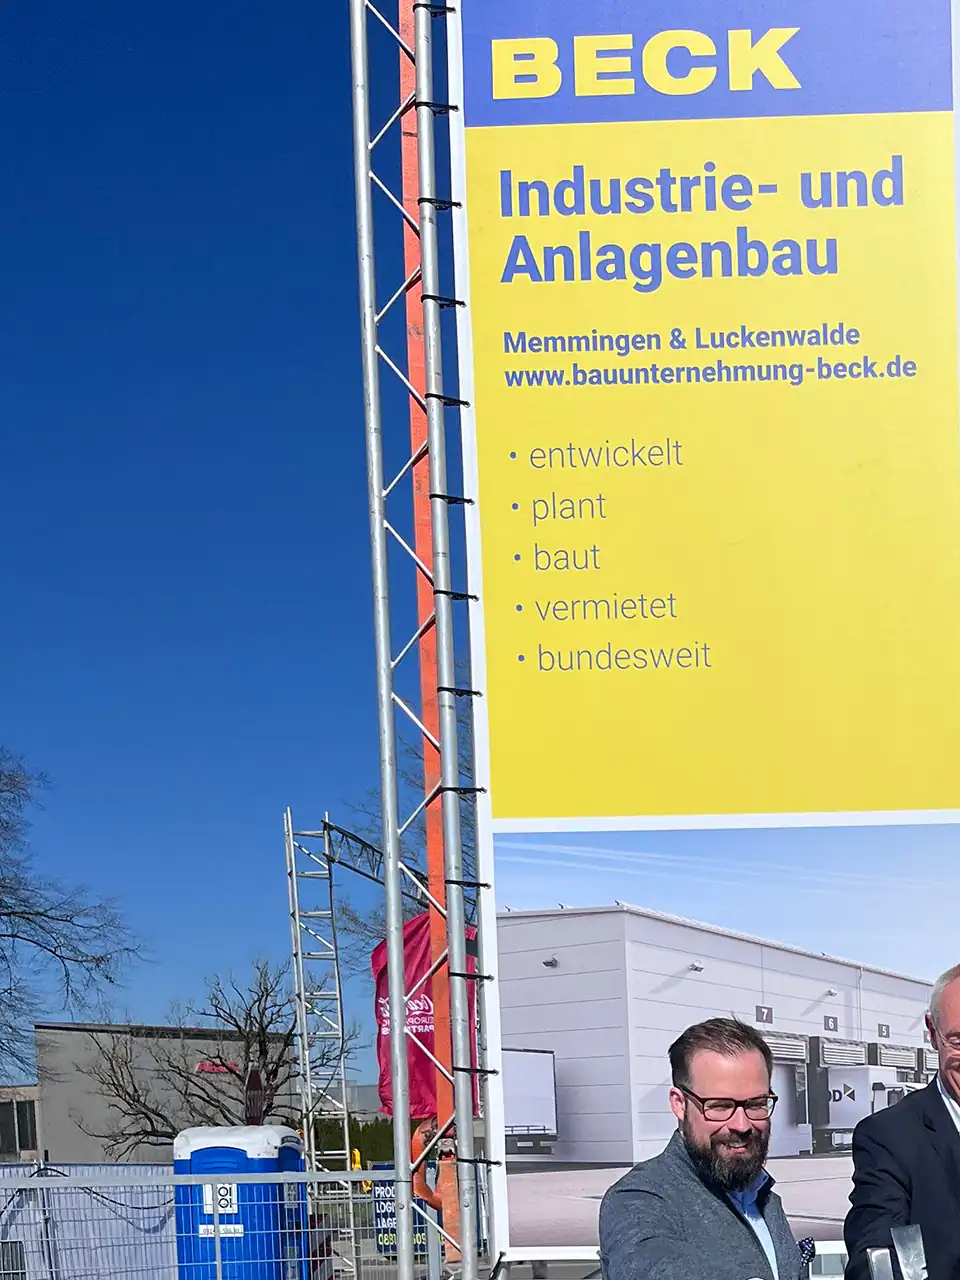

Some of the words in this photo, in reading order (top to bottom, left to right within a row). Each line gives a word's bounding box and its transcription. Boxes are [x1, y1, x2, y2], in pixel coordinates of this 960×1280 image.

[491, 27, 802, 100] BECK
[500, 161, 778, 218] Industrie-
[801, 155, 905, 208] und
[500, 226, 839, 293] Anlagenbau
[503, 329, 661, 358] Memmingen
[670, 328, 686, 349] &
[695, 323, 861, 349] Luckenwalde
[504, 355, 917, 387] www.bauunternehmung-beck.de
[529, 438, 684, 469] entwickelt
[532, 492, 607, 527] plant
[534, 543, 601, 571] baut
[535, 593, 677, 621] vermietet
[537, 641, 712, 672] bundesweit
[761, 1008, 768, 1020] 7
[828, 1018, 834, 1029] 6
[881, 1026, 887, 1036] 5
